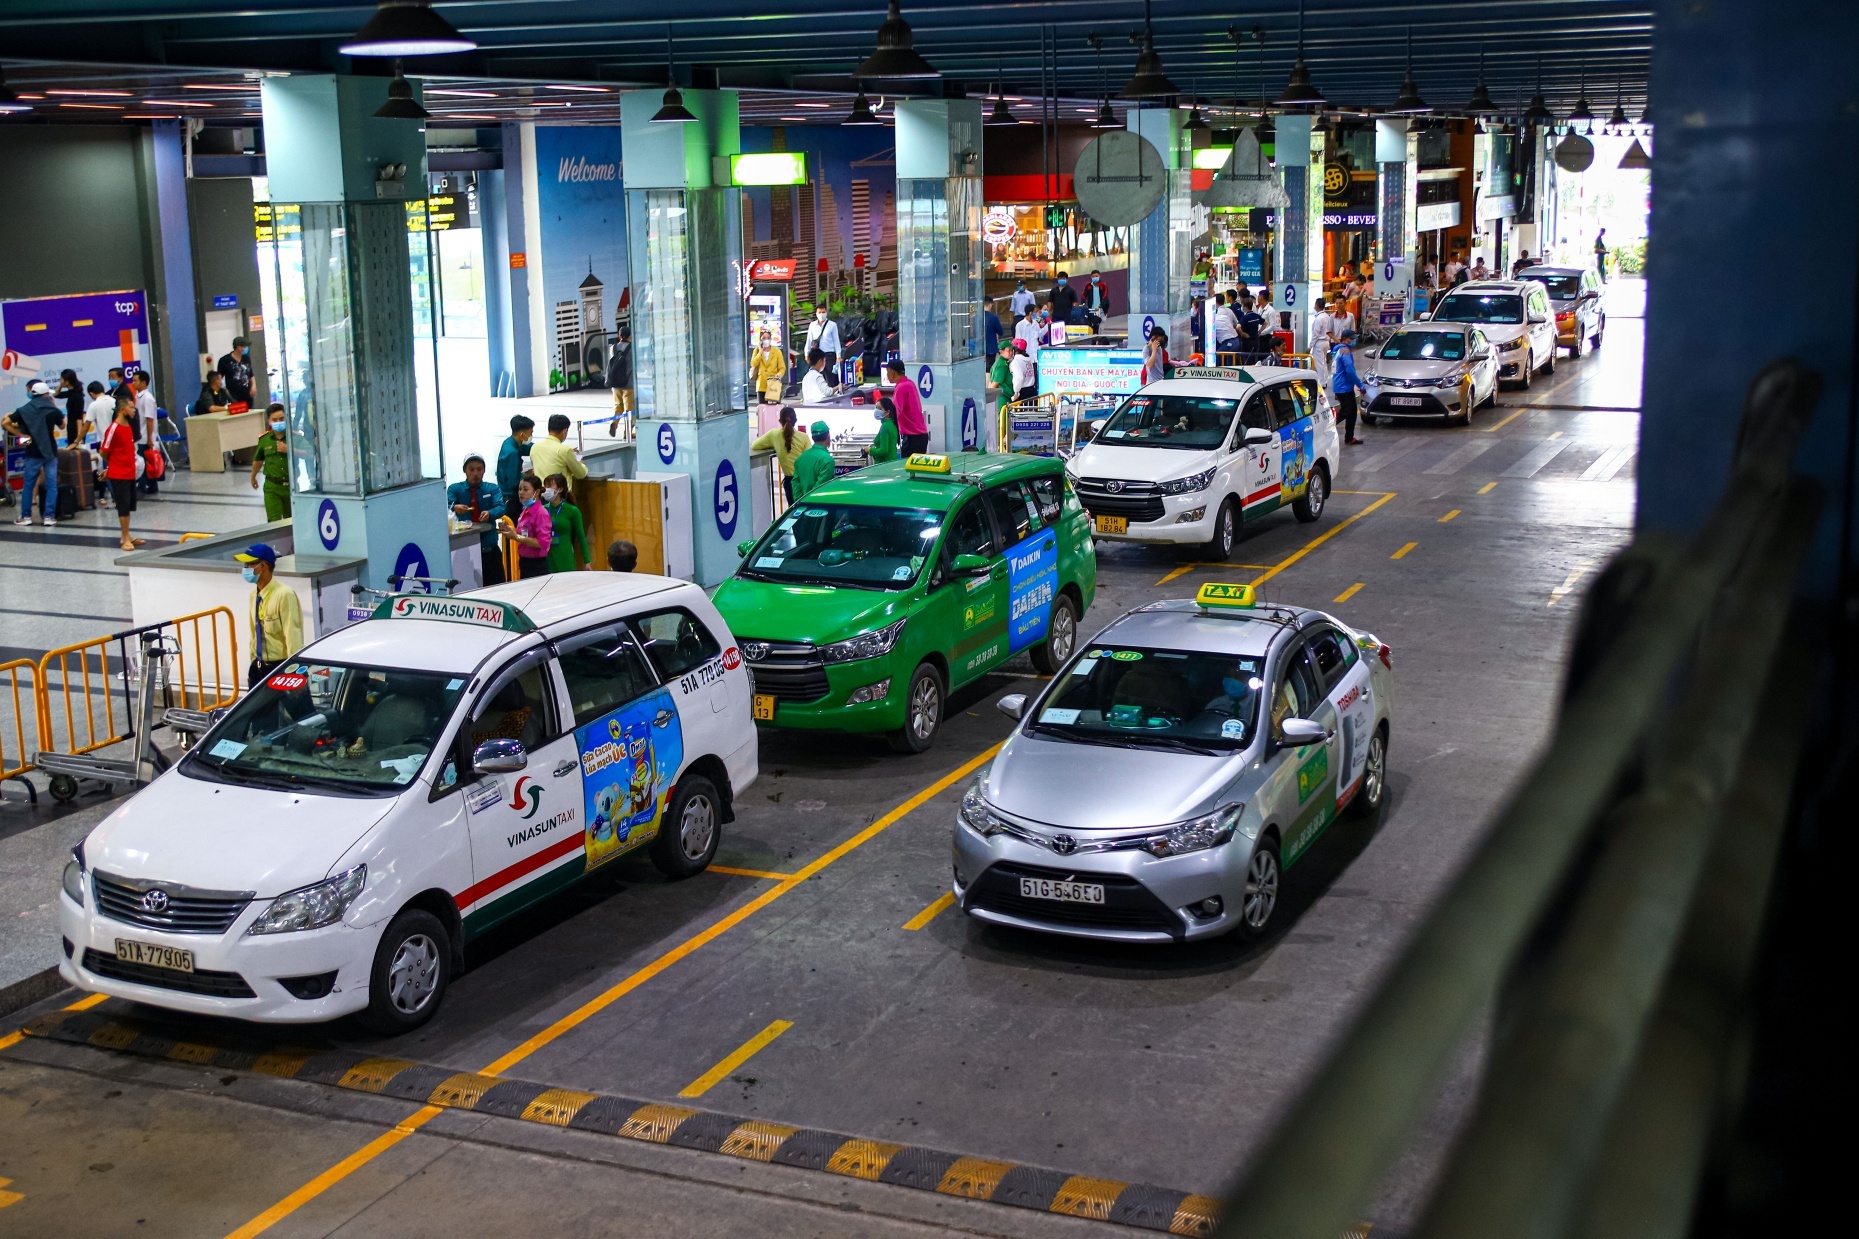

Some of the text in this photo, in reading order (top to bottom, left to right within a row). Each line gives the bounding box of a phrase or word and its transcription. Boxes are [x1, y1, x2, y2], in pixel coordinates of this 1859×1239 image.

[558, 156, 616, 183] Welcome
[1387, 266, 1391, 278] 1
[1286, 288, 1294, 303] 2
[115, 301, 134, 315] tcp
[1144, 320, 1153, 337] 3
[920, 371, 932, 392] 4
[1190, 369, 1222, 378] VINASUN
[963, 407, 976, 446] 4
[660, 431, 673, 457] 5
[718, 474, 735, 525] 5
[321, 509, 338, 541] 6
[1104, 517, 1118, 525] 51H
[1018, 549, 1041, 570] DAIKIN
[1012, 581, 1052, 621] DAIKIN
[1206, 586, 1242, 597] TAXI
[419, 601, 502, 623] VINASUN TAXI
[271, 676, 304, 688] 14150
[680, 673, 699, 695] 51A
[1337, 685, 1360, 713] TOSHIBA
[594, 743, 612, 758] Cacao
[507, 808, 575, 848] VINASUN TAXI
